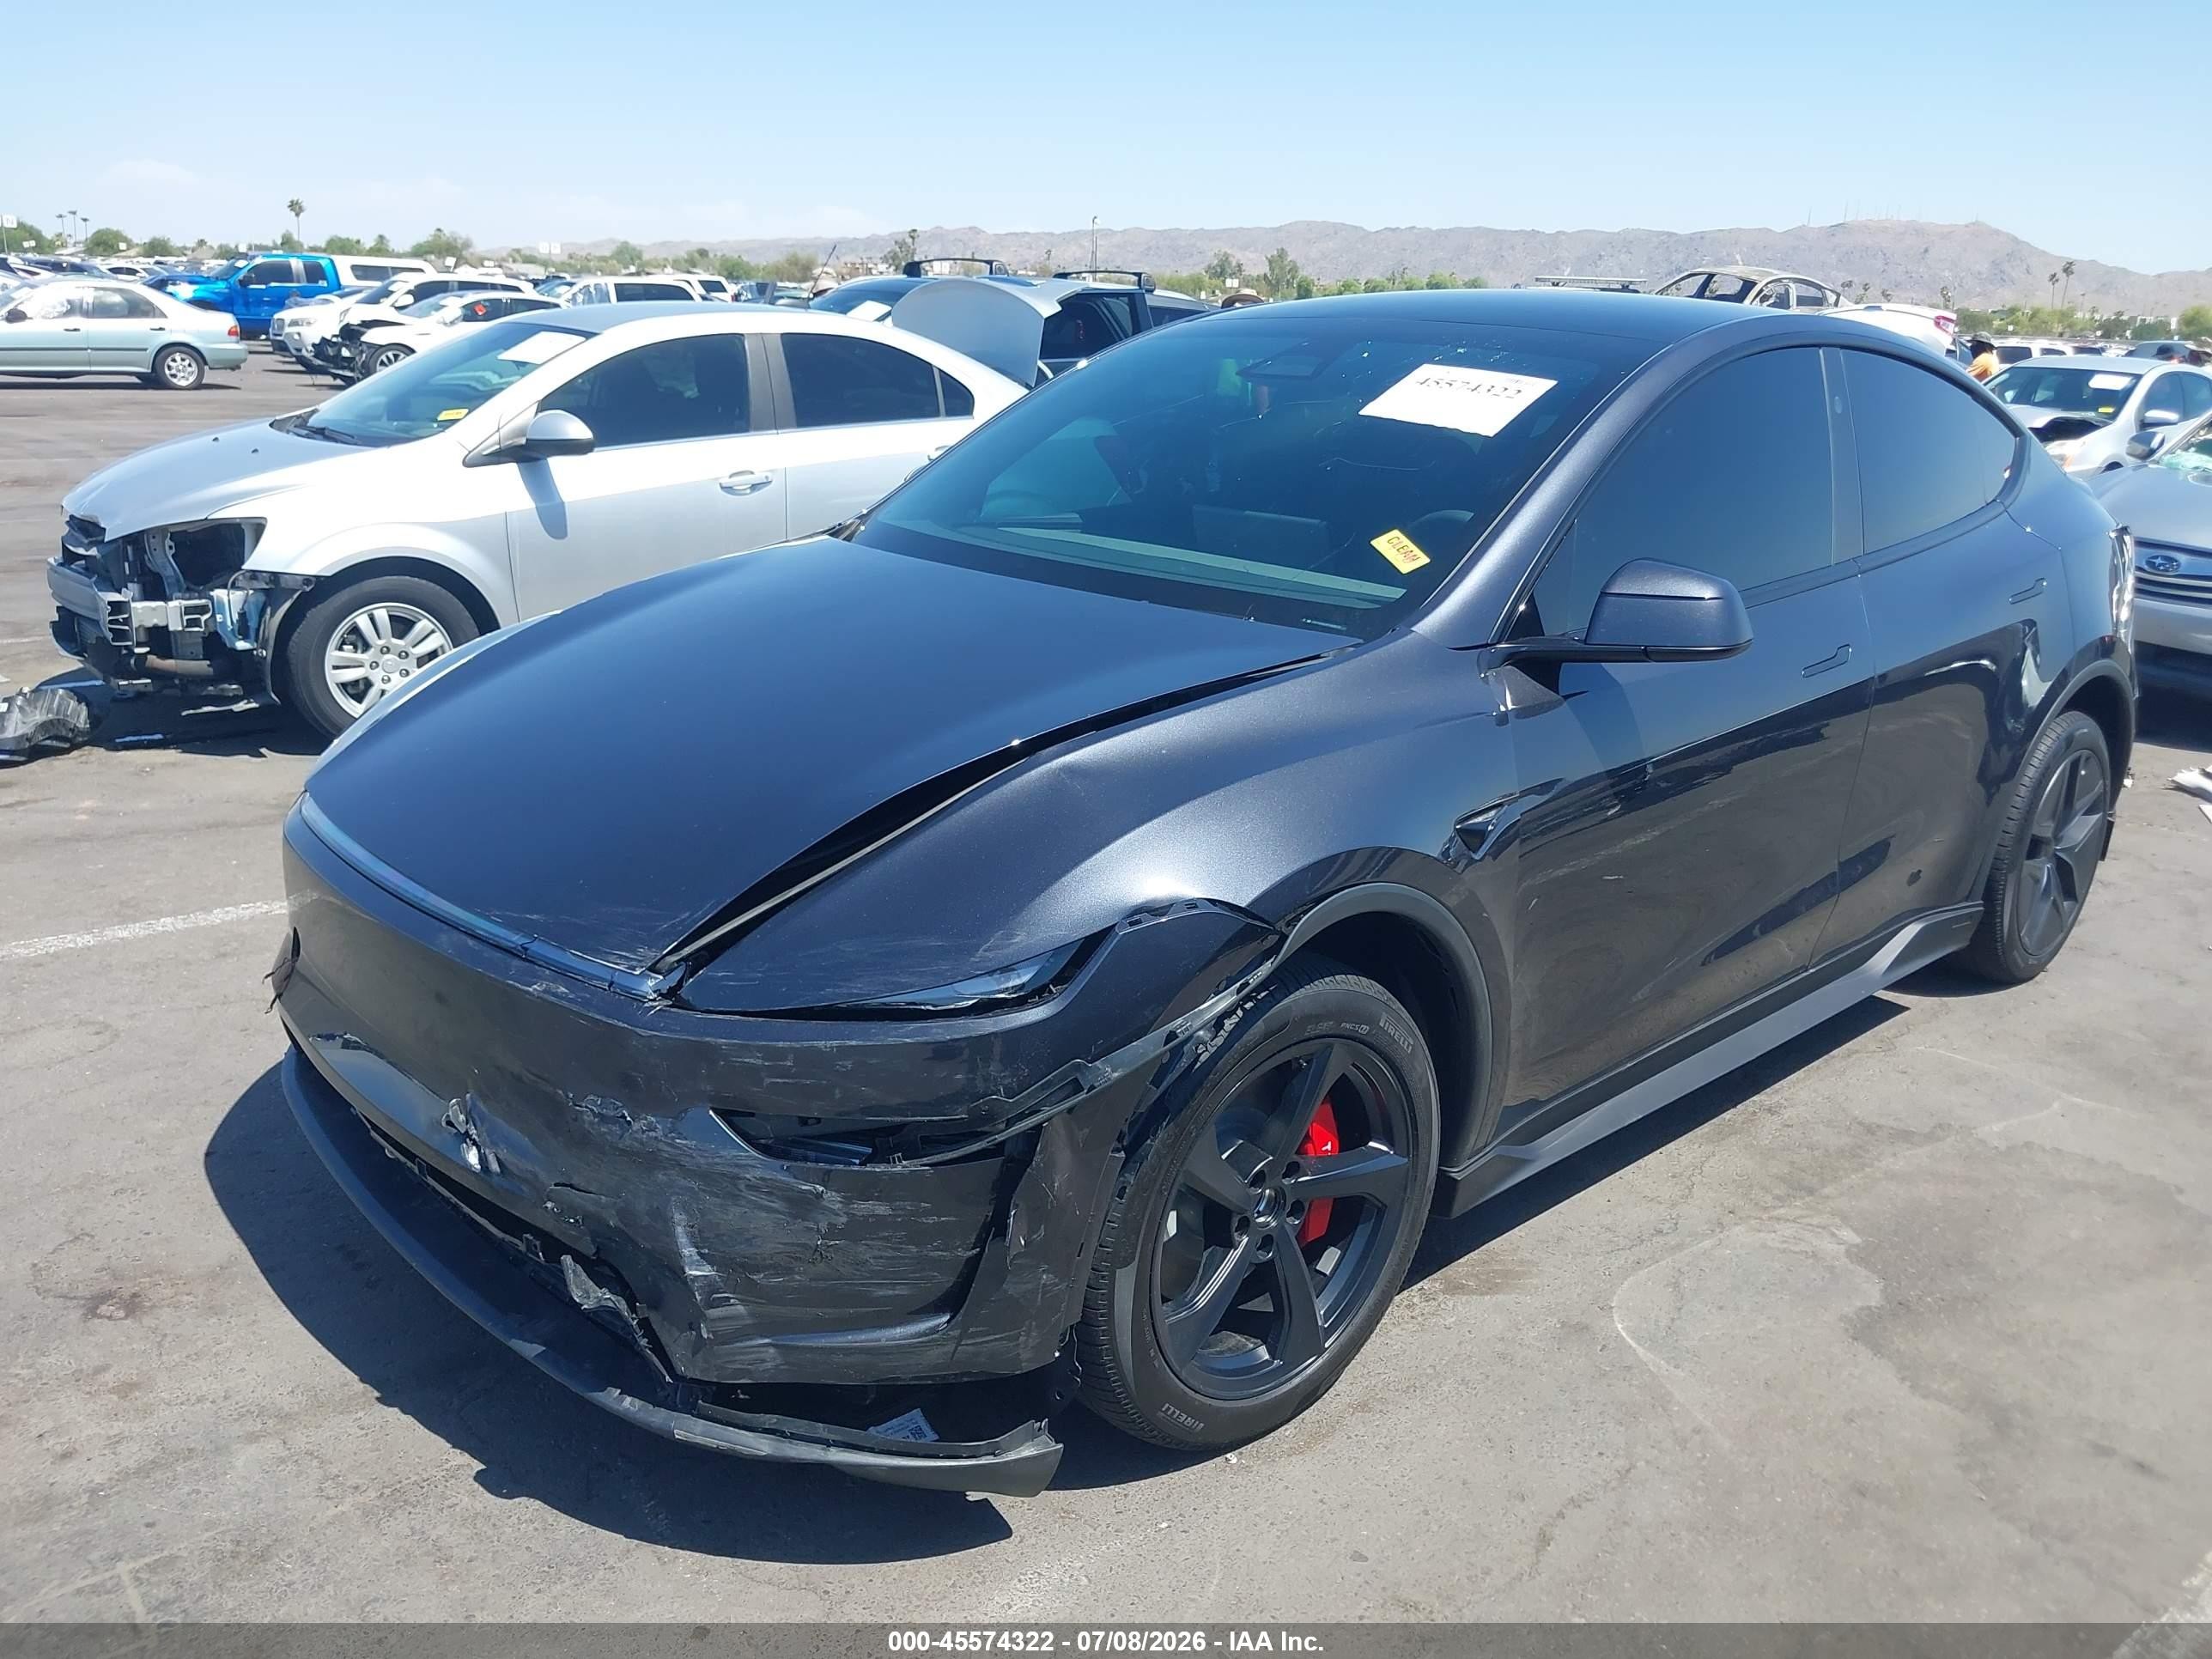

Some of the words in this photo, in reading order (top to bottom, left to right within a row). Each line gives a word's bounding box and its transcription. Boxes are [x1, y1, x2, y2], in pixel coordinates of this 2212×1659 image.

[1414, 377, 1523, 399] 45574322
[1385, 536, 1422, 564] CLEAN
[1379, 1012, 1414, 1054] PIRELLI
[1155, 1402, 1206, 1433] PIRELLI
